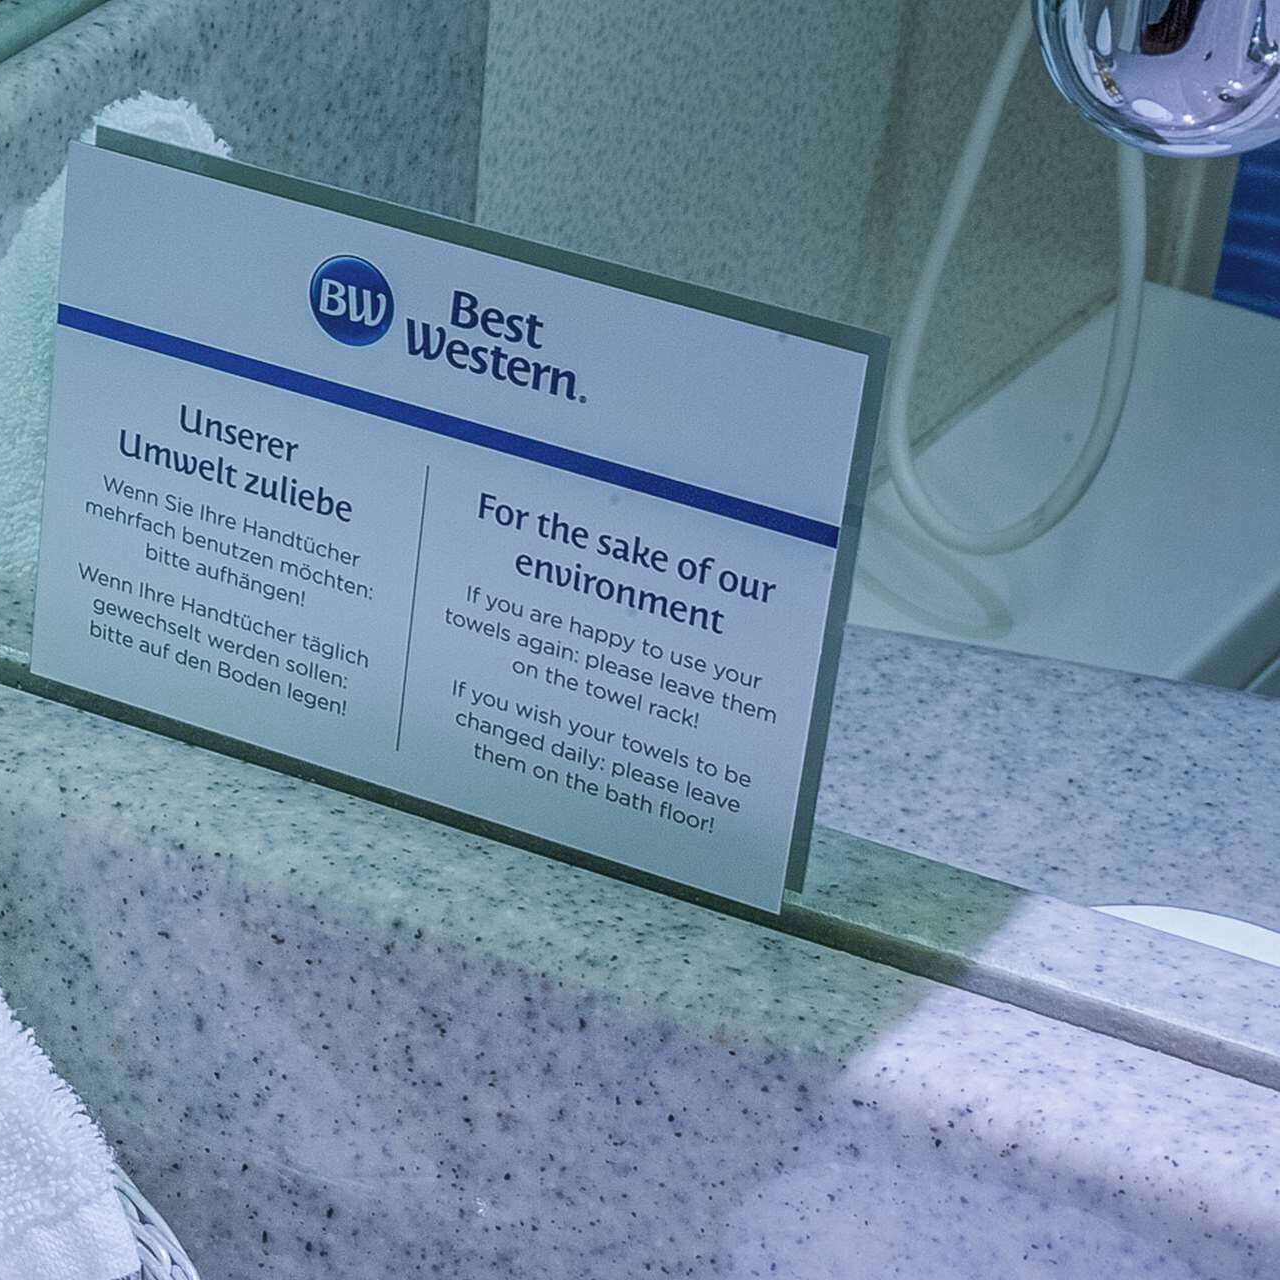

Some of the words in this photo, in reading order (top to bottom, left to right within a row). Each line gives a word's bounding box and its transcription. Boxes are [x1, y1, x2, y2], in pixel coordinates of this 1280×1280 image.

[319, 278, 387, 327] BW
[450, 290, 544, 349] Best
[119, 429, 238, 488] Umwelt
[244, 472, 353, 522] zuliebe
[179, 404, 299, 462] Unserer
[85, 499, 175, 540] mehrfach
[182, 526, 273, 570] benutzen
[280, 559, 374, 600] möchten:
[103, 475, 158, 506] Wenn
[165, 494, 193, 517] Sie
[200, 504, 237, 530] Ihre
[243, 517, 361, 568] Handtücher
[477, 492, 529, 531] For
[537, 512, 589, 550] the
[596, 536, 669, 574] sake
[677, 556, 715, 585] of
[718, 568, 777, 604] our
[77, 562, 132, 594] Wenn
[139, 582, 175, 607] Ihre
[181, 595, 297, 644] Handtücher
[302, 632, 370, 669] täglich
[145, 542, 190, 571] bitte
[195, 561, 306, 607] aufhängen!
[515, 553, 726, 635] environment
[89, 620, 134, 648] bitte
[138, 638, 170, 660] auf
[174, 649, 211, 674] den
[217, 661, 281, 695] Boden
[286, 682, 347, 717] legen!
[92, 597, 202, 644] gewechselt
[207, 633, 280, 667] werden
[284, 658, 348, 690] sollen:
[444, 608, 511, 643] towels
[516, 631, 580, 664] again:
[584, 651, 654, 686] please
[659, 672, 715, 705] leave
[720, 691, 778, 724] them
[466, 585, 481, 603] If
[485, 594, 523, 618] you
[529, 607, 563, 629] are
[569, 616, 635, 654] happy
[641, 638, 664, 659] to
[670, 652, 707, 673] use
[712, 661, 763, 690] your
[452, 679, 467, 697] If
[470, 687, 510, 712] you
[515, 700, 562, 729] wish
[567, 718, 617, 745] your
[622, 733, 689, 769] towels
[696, 756, 718, 777] to
[724, 764, 752, 788] be
[511, 659, 539, 680] on
[545, 667, 579, 692] the
[585, 678, 643, 712] towel
[648, 700, 700, 730] rack!
[455, 711, 545, 752] changed
[550, 740, 606, 771] daily:
[610, 760, 680, 794] please
[685, 780, 741, 813] leave
[473, 742, 526, 774] them
[533, 764, 559, 785] on
[565, 771, 599, 797] the
[605, 785, 653, 814] bath
[659, 801, 715, 834] floor!
